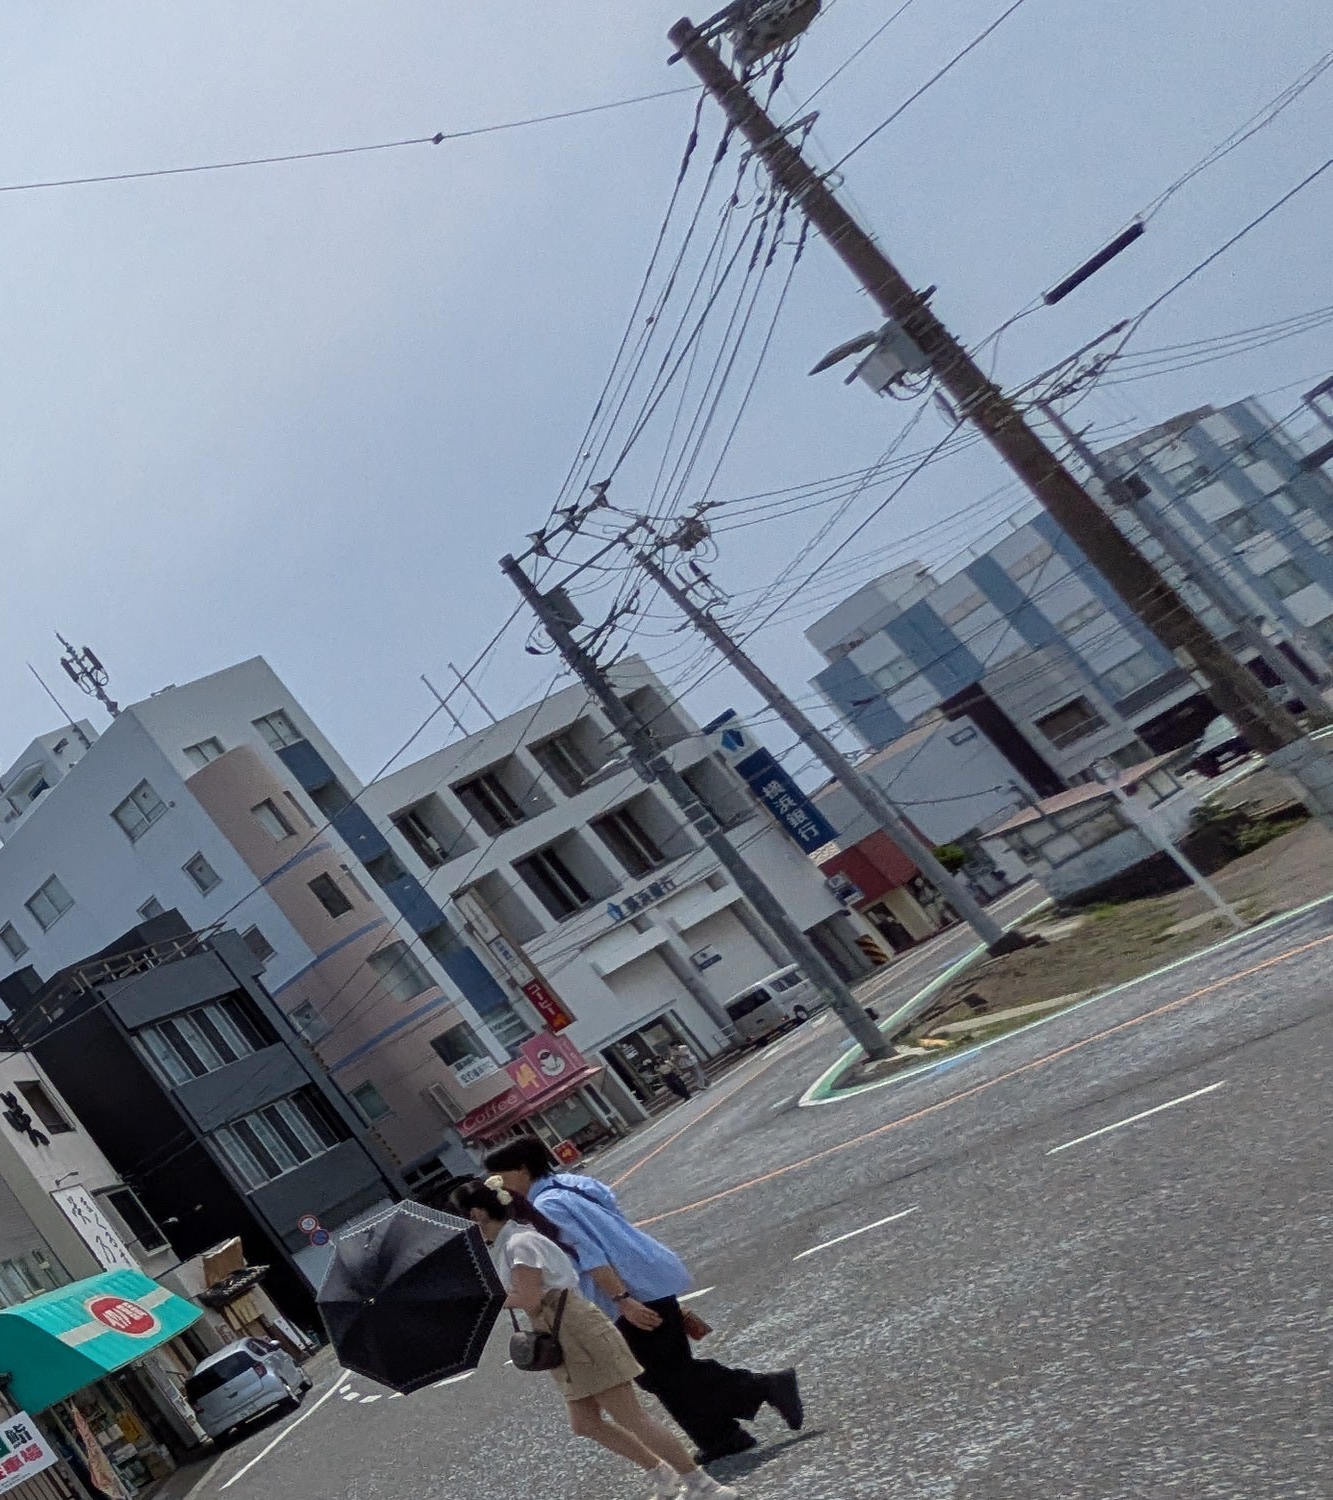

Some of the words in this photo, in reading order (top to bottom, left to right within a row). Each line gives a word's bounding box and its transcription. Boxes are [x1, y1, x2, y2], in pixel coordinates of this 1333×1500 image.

[762, 781, 821, 843] 横浜銀行
[528, 984, 555, 1015] コーヒー
[462, 1093, 520, 1131] Coffee
